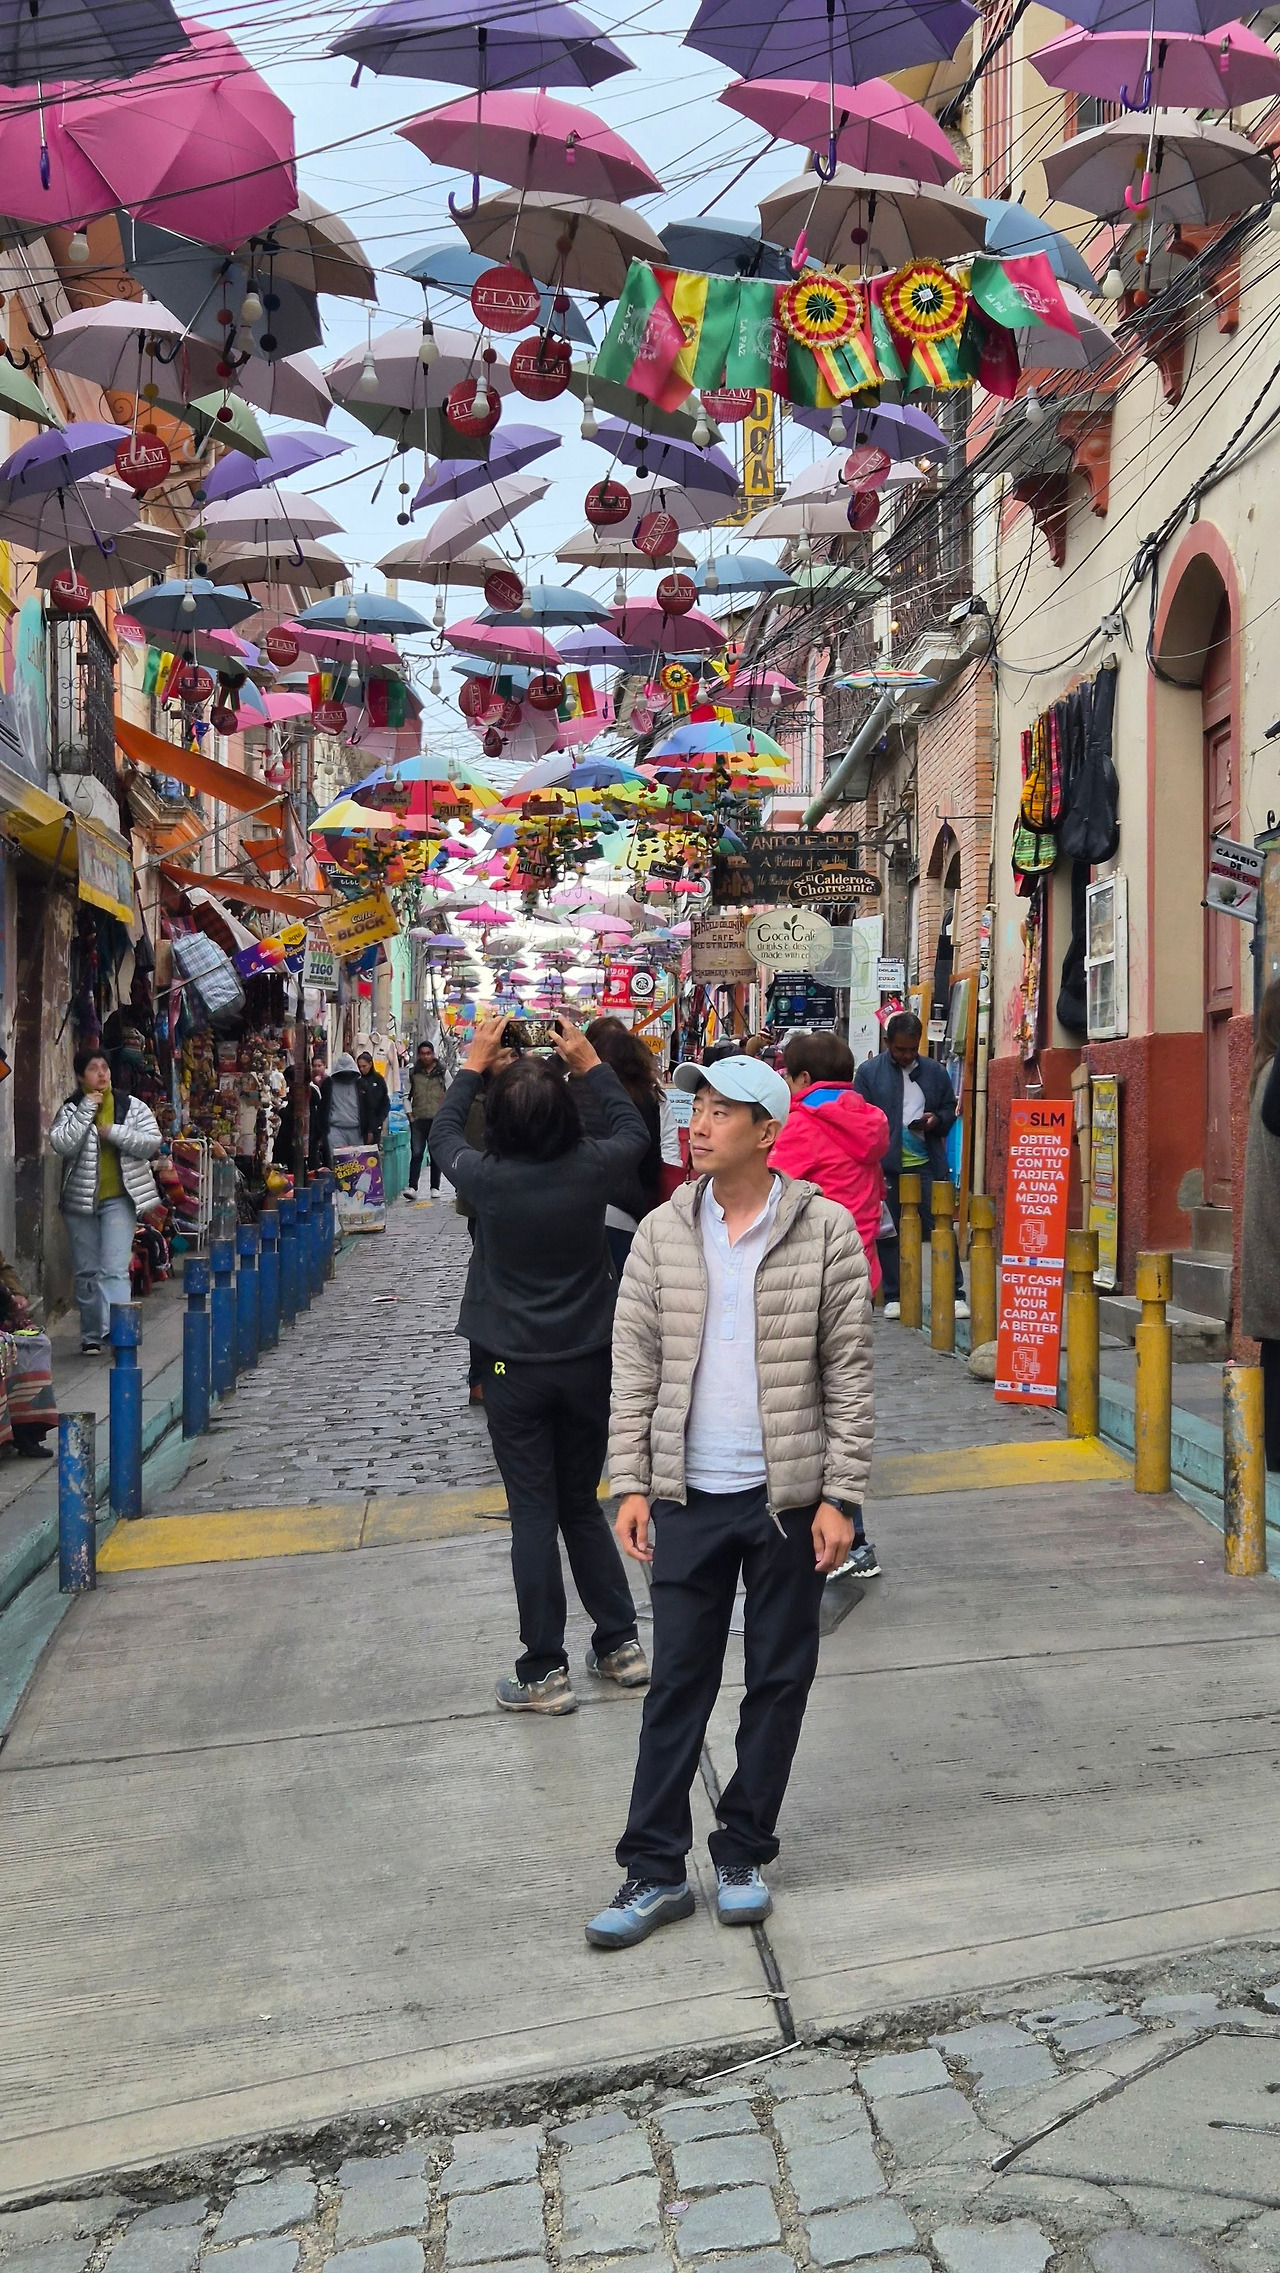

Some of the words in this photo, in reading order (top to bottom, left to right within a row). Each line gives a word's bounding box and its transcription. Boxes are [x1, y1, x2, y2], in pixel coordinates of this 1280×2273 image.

[1216, 848, 1258, 867] CAMBIO
[1230, 861, 1242, 871] DE
[815, 874, 865, 885] Caldero
[1211, 866, 1257, 887] MONEDA
[799, 884, 873, 896] Chorreante
[338, 915, 386, 940] BLOCK
[757, 923, 790, 942] Coca
[757, 943, 783, 951] drinks
[311, 952, 334, 965] VIVA
[310, 963, 333, 976] TIGO
[1030, 1112, 1065, 1127] SLM
[1019, 1135, 1061, 1145] OBTEN
[1010, 1146, 1069, 1157] EFECTIVO
[1016, 1158, 1043, 1168] CON
[1045, 1158, 1062, 1168] TU
[1012, 1169, 1065, 1180] TARJETA
[1018, 1181, 1027, 1191] A
[1030, 1182, 1057, 1192] UNA
[1016, 1193, 1058, 1204] MEJOR
[1020, 1204, 1052, 1215] TASA
[1002, 1273, 1026, 1283] GET
[1028, 1275, 1062, 1286] CASH
[1015, 1286, 1047, 1297] WITH
[1013, 1297, 1047, 1309] YOUR
[1003, 1308, 1038, 1320] CARD
[1040, 1312, 1057, 1321] AT
[1000, 1320, 1009, 1330] A
[1012, 1321, 1059, 1334] BETTER
[1013, 1333, 1044, 1345] RATE
